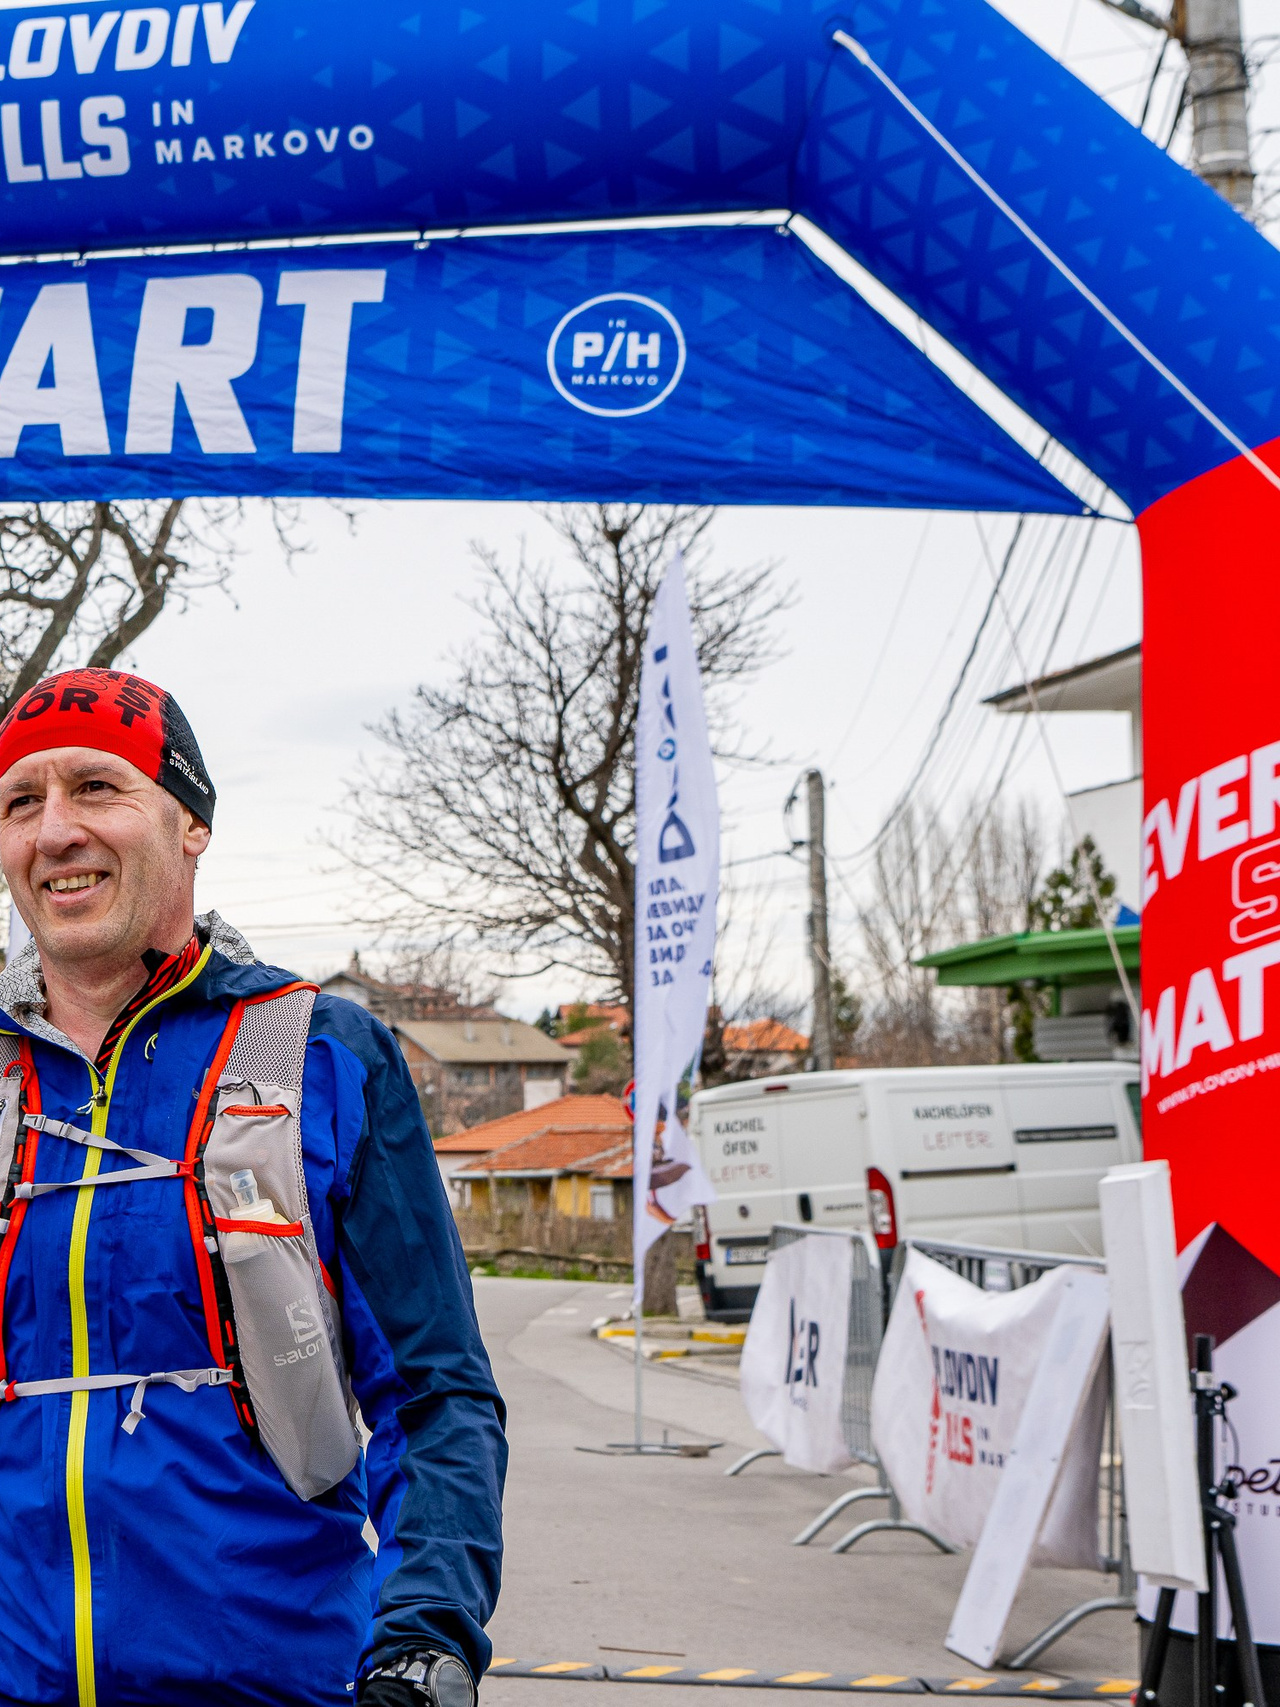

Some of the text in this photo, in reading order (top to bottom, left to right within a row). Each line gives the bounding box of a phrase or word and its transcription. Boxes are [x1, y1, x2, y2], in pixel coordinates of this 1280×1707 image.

[152, 100, 195, 127] IN
[154, 123, 376, 166] MARKOVO
[572, 331, 660, 372] P/H
[571, 374, 659, 386] MARKOVO
